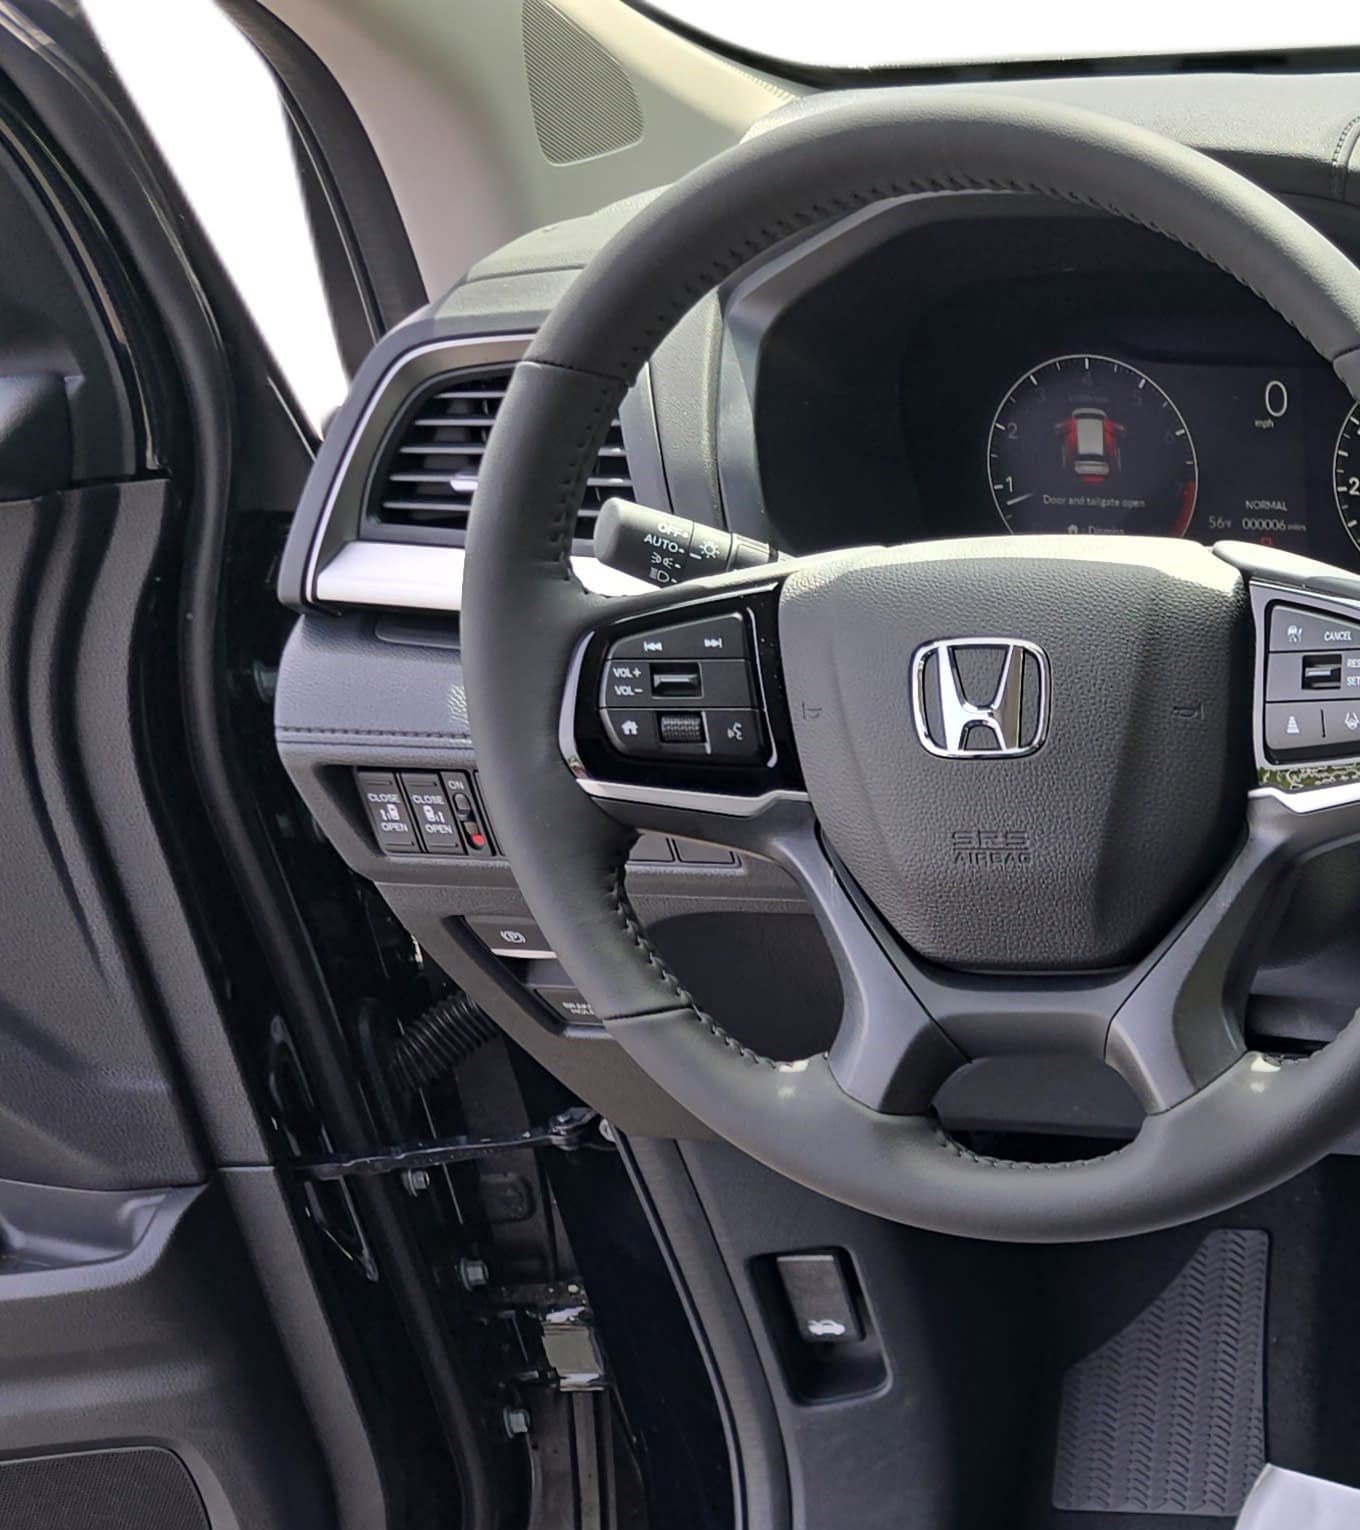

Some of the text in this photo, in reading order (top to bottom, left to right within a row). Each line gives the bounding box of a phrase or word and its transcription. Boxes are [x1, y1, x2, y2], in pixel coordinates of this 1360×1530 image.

[1265, 380, 1288, 417] 0
[1245, 500, 1288, 511] NORMAL
[643, 534, 678, 552] AUTO
[1324, 631, 1353, 642] CANCEL
[448, 780, 464, 790] ON
[367, 793, 401, 803] CLOSE
[412, 795, 445, 804] CLOSE
[381, 822, 408, 832] OPEN
[425, 824, 453, 833] OPEN
[951, 830, 1030, 846] SRS
